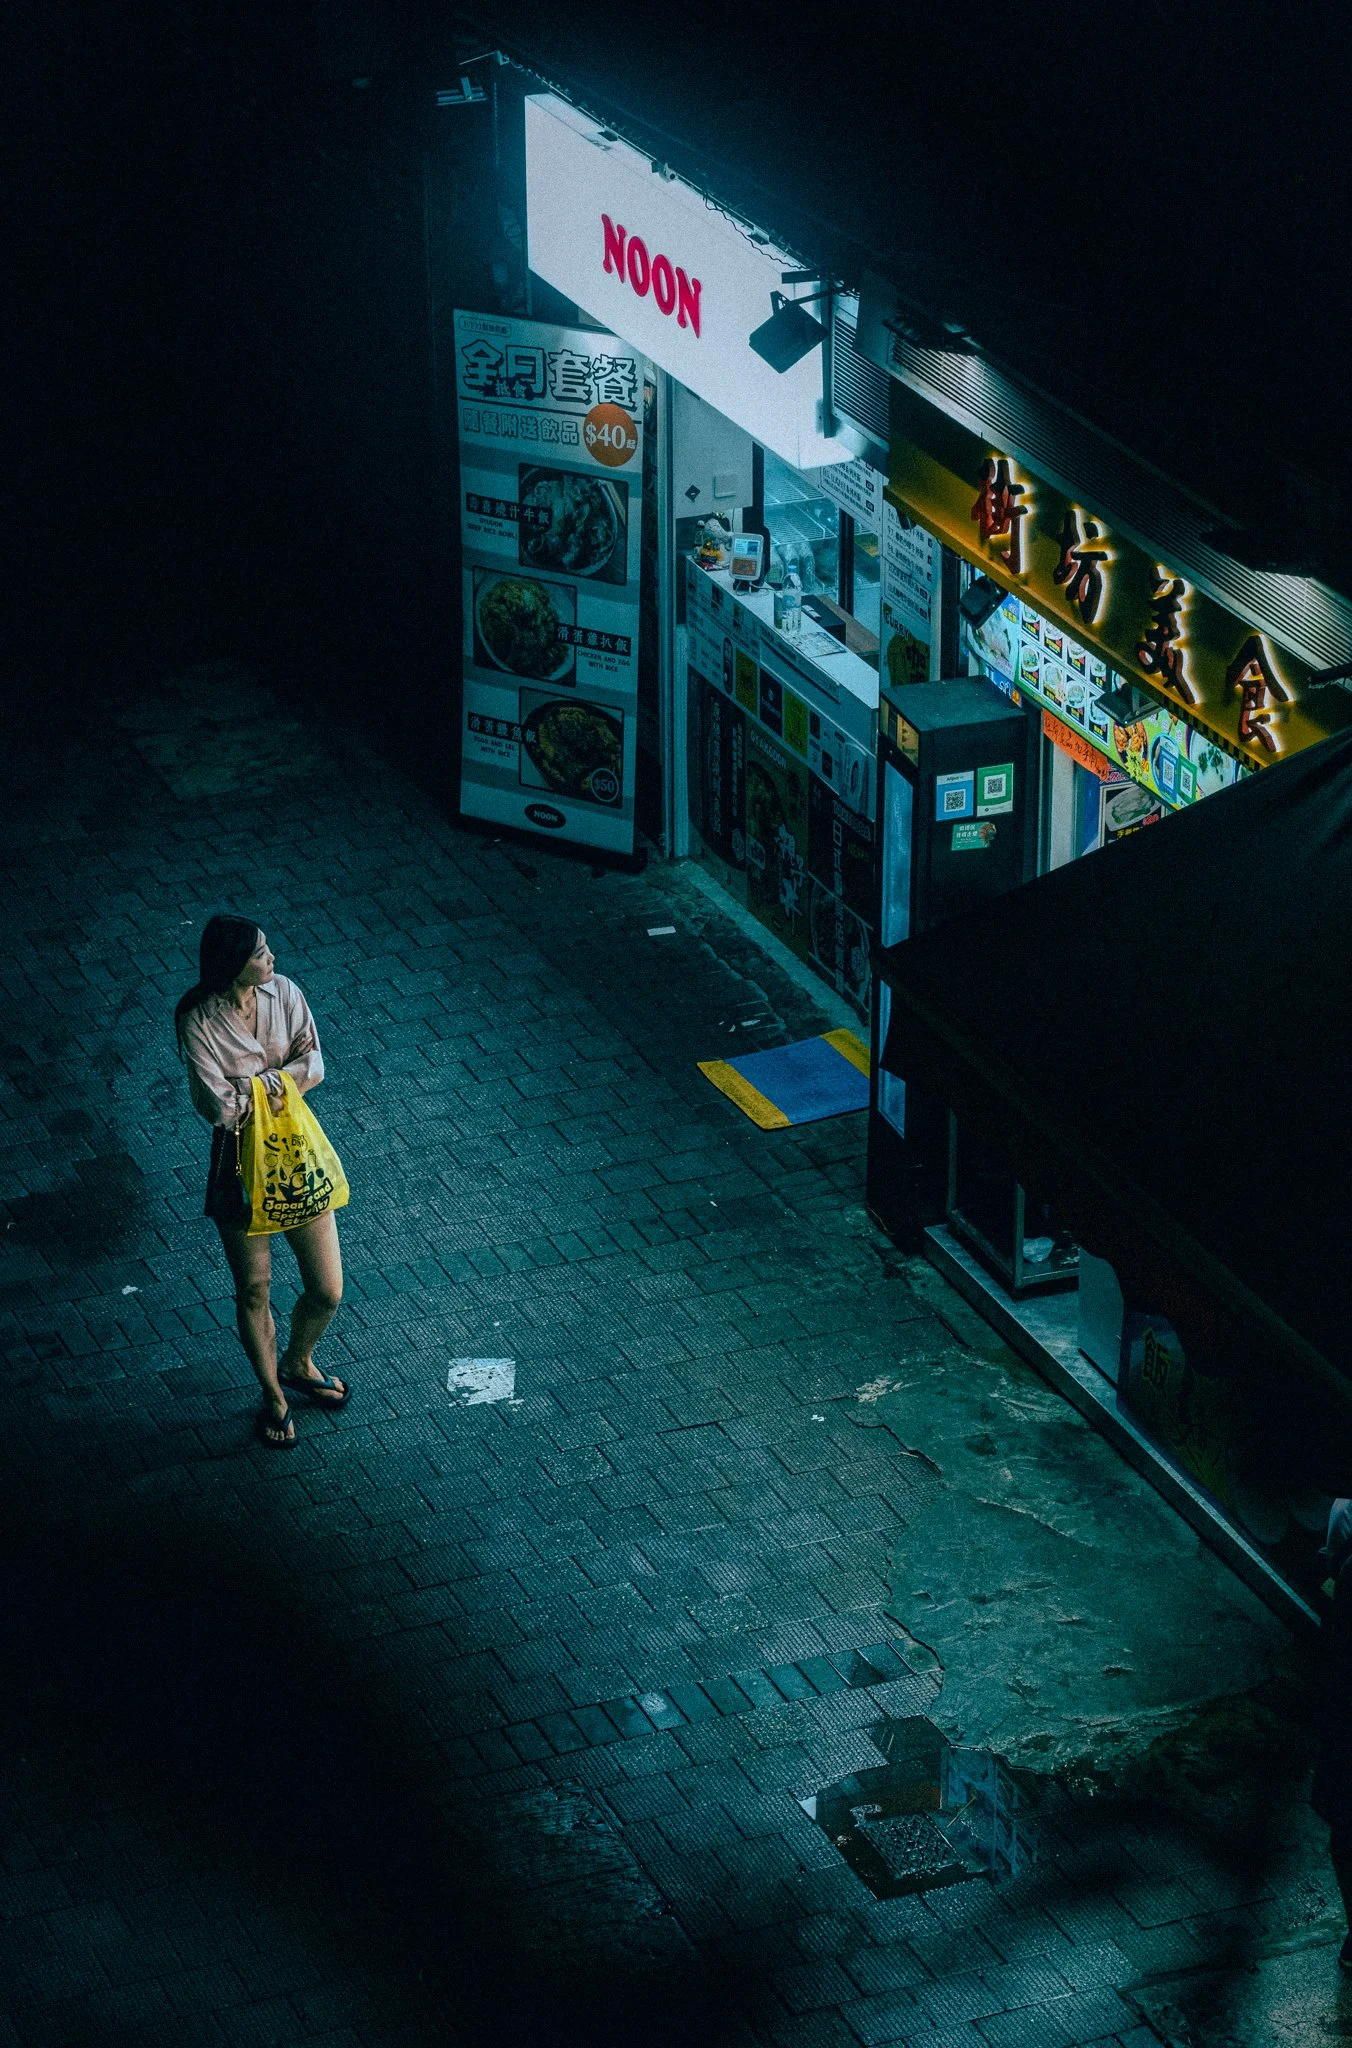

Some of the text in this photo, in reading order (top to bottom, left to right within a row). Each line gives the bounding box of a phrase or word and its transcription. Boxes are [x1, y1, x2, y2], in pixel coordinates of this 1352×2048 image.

[601, 213, 702, 339] NOON
[461, 339, 638, 412] 全日套餐
[463, 407, 580, 447] 隨餐附送飲品
[971, 457, 1294, 753] 街坊美食
[885, 612, 912, 640] CURRY
[577, 650, 602, 660] CHICKEN
[604, 655, 616, 663] AND
[533, 810, 558, 822] NOON
[264, 1180, 332, 1212] Japan Band
